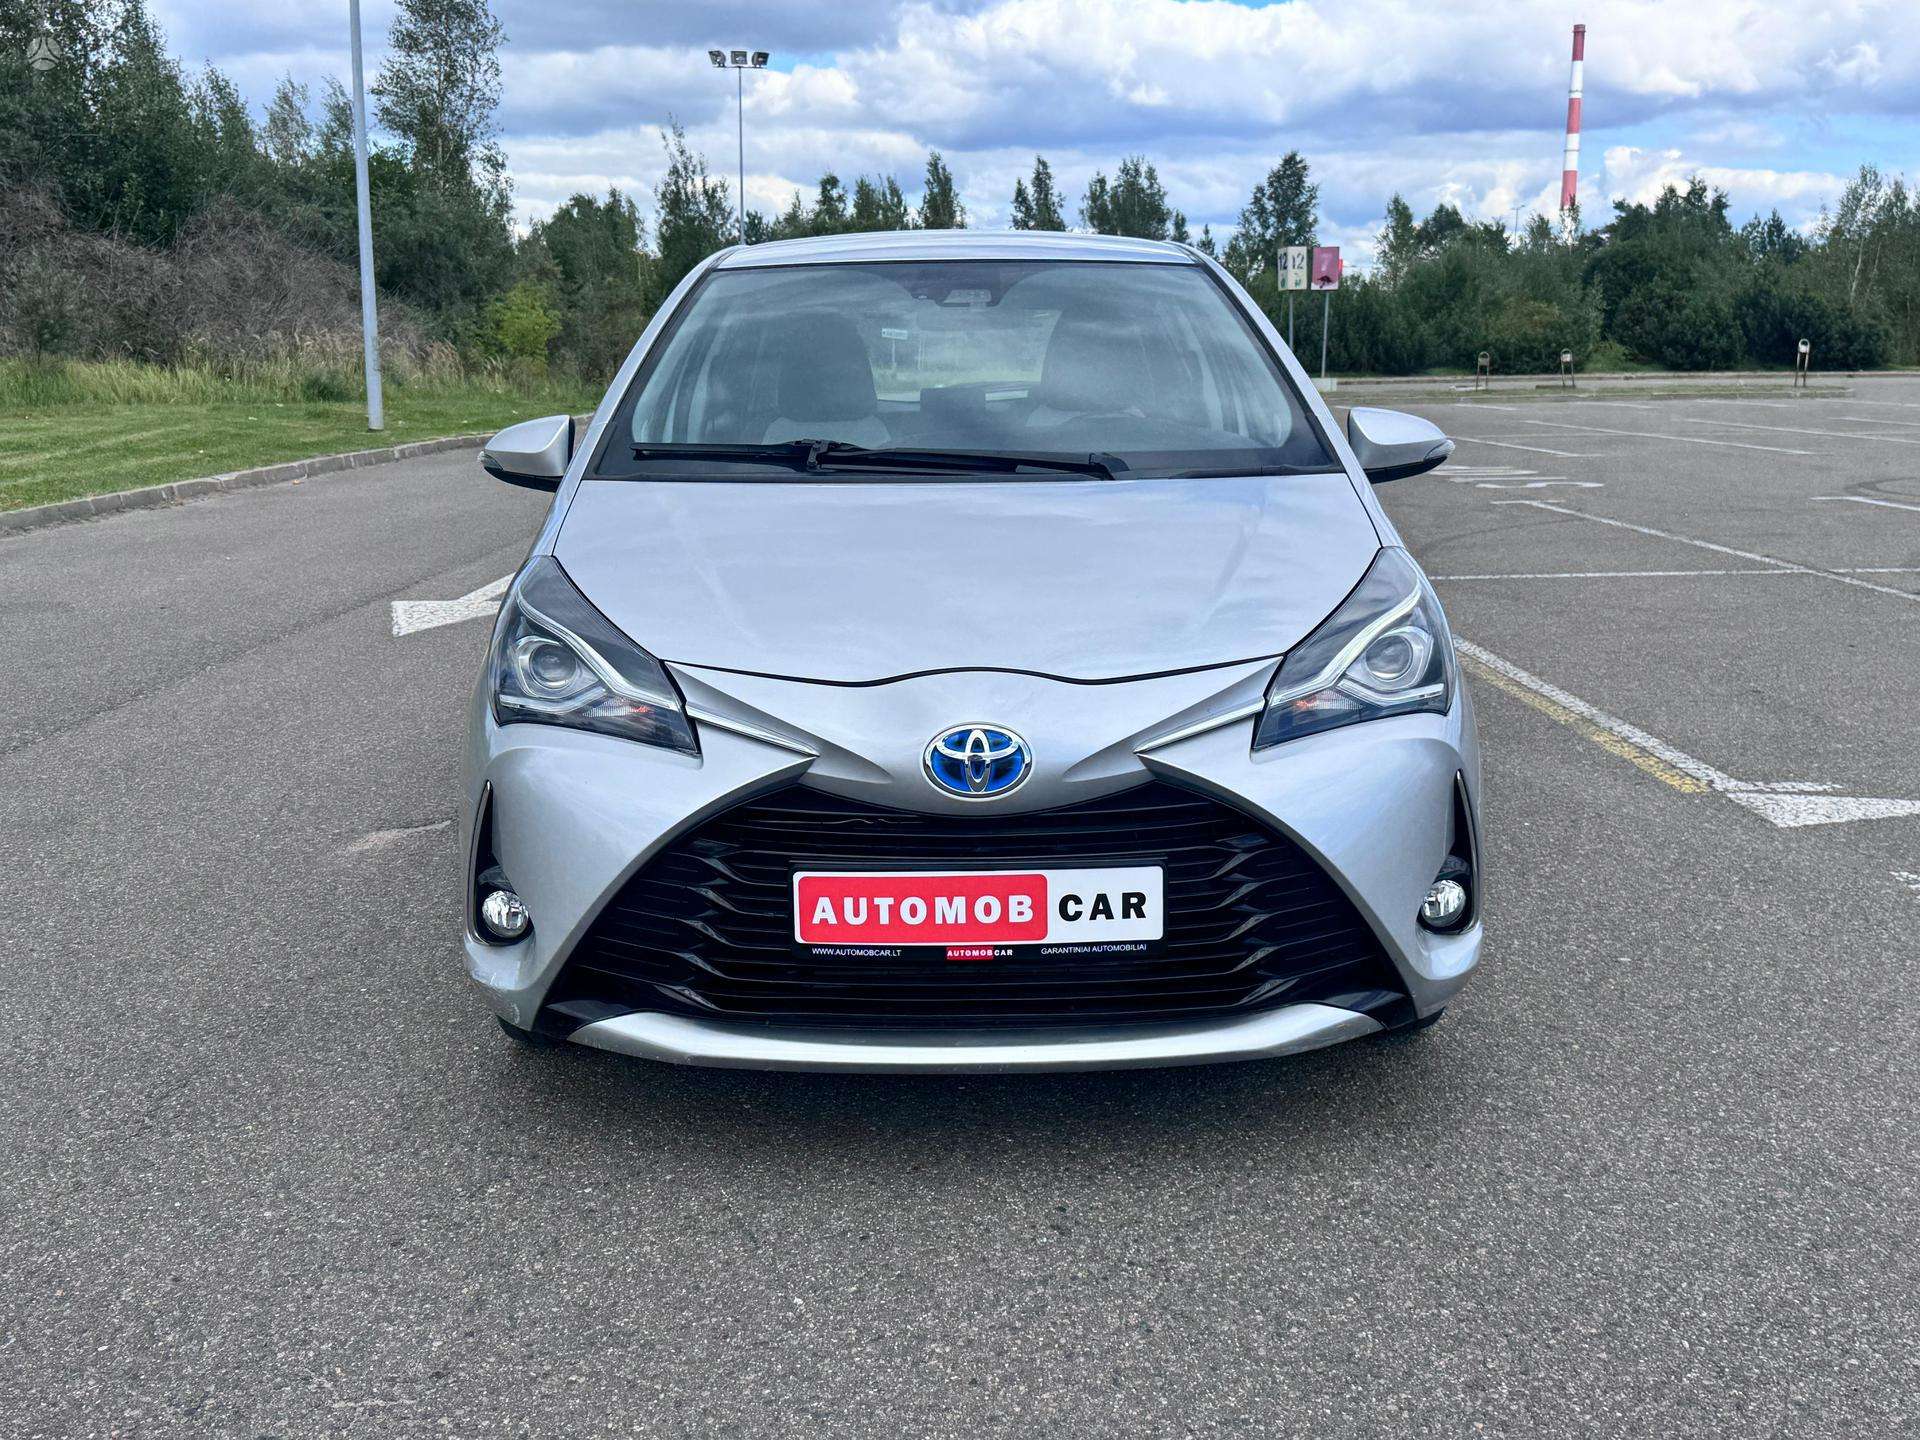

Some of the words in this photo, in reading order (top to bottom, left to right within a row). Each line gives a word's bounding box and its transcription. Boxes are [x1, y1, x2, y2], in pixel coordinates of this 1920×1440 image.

[1279, 252, 1288, 270] 12
[1292, 252, 1305, 270] 12
[812, 895, 1034, 925] AUTOMOB
[1058, 891, 1147, 922] CAR
[811, 947, 902, 957] WWW.AUTOMOBCAR.LT
[1041, 945, 1091, 954] GARANTINIAI
[1091, 944, 1146, 953] AUTOMOBILIAI
